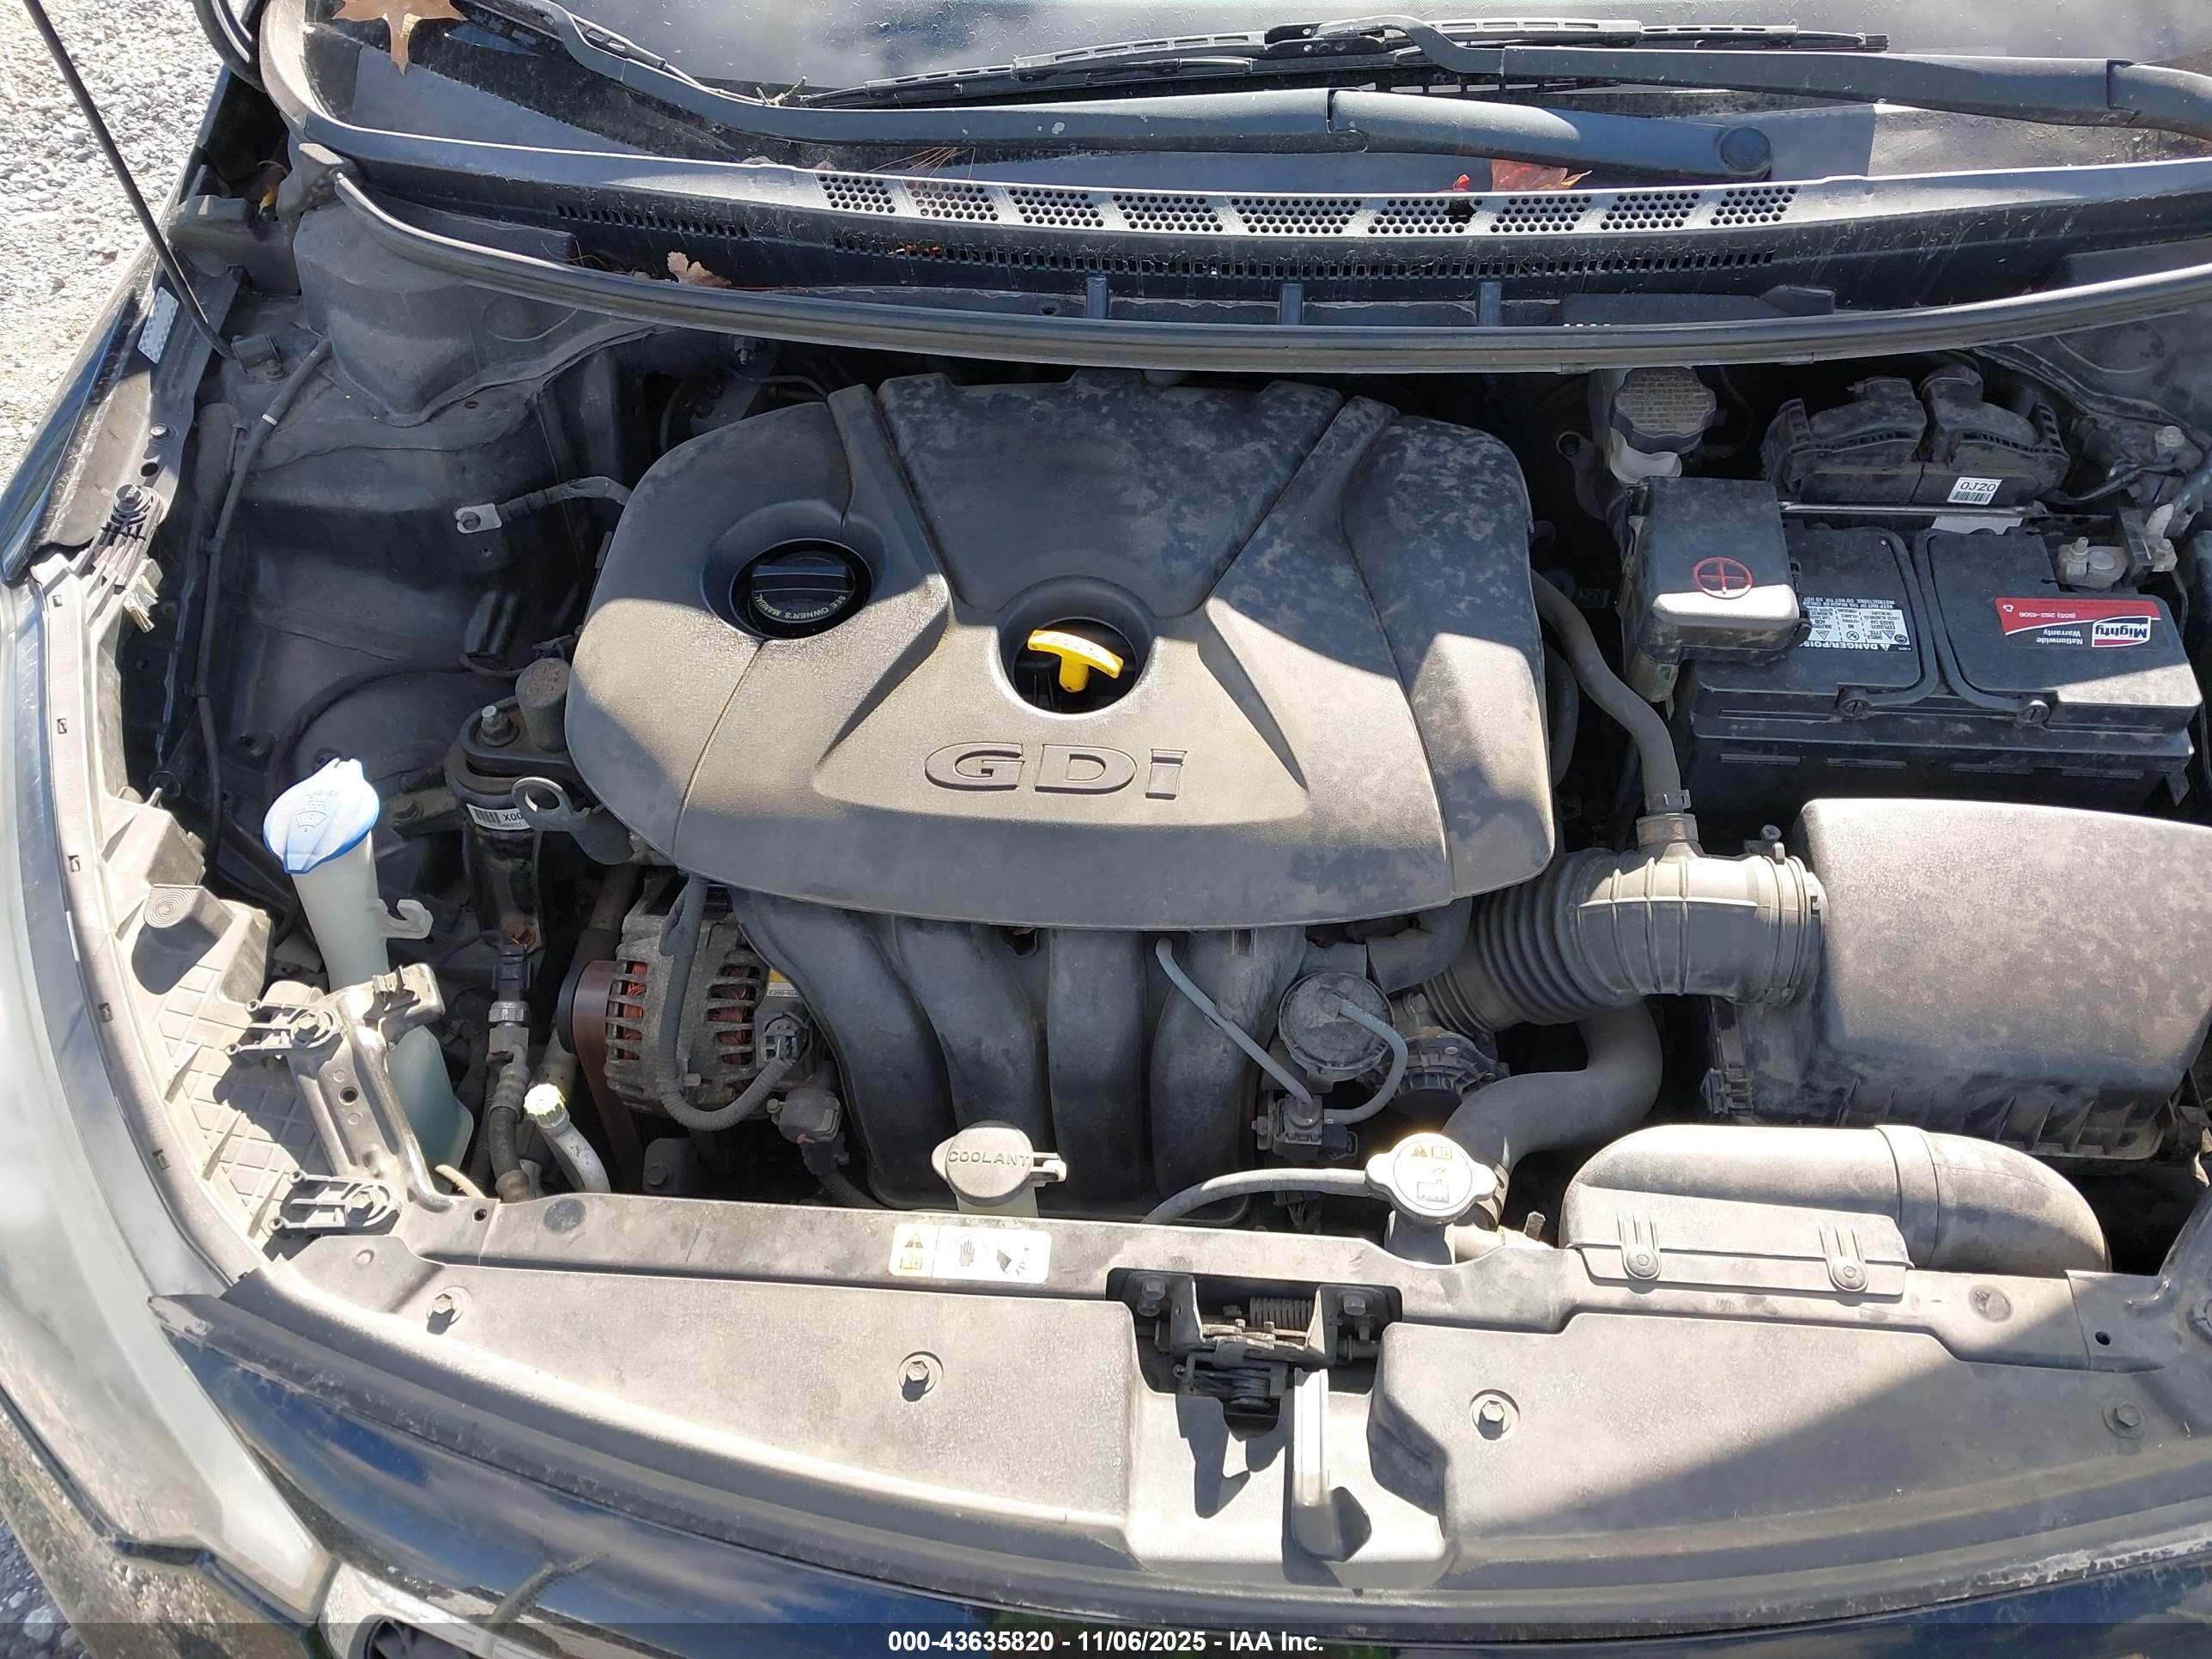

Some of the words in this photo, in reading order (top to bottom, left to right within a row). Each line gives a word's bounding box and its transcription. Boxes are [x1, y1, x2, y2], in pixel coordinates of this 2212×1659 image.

[755, 592, 782, 617] MANUAL
[829, 594, 847, 609] SEE
[783, 606, 830, 619] OWNER'S
[2043, 629, 2081, 637] Warranty
[2095, 624, 2148, 639] Mighty
[1799, 641, 1879, 650] DANGER/POIS
[2036, 636, 2083, 645] Nationwide
[948, 1151, 1030, 1167] COOLANT
